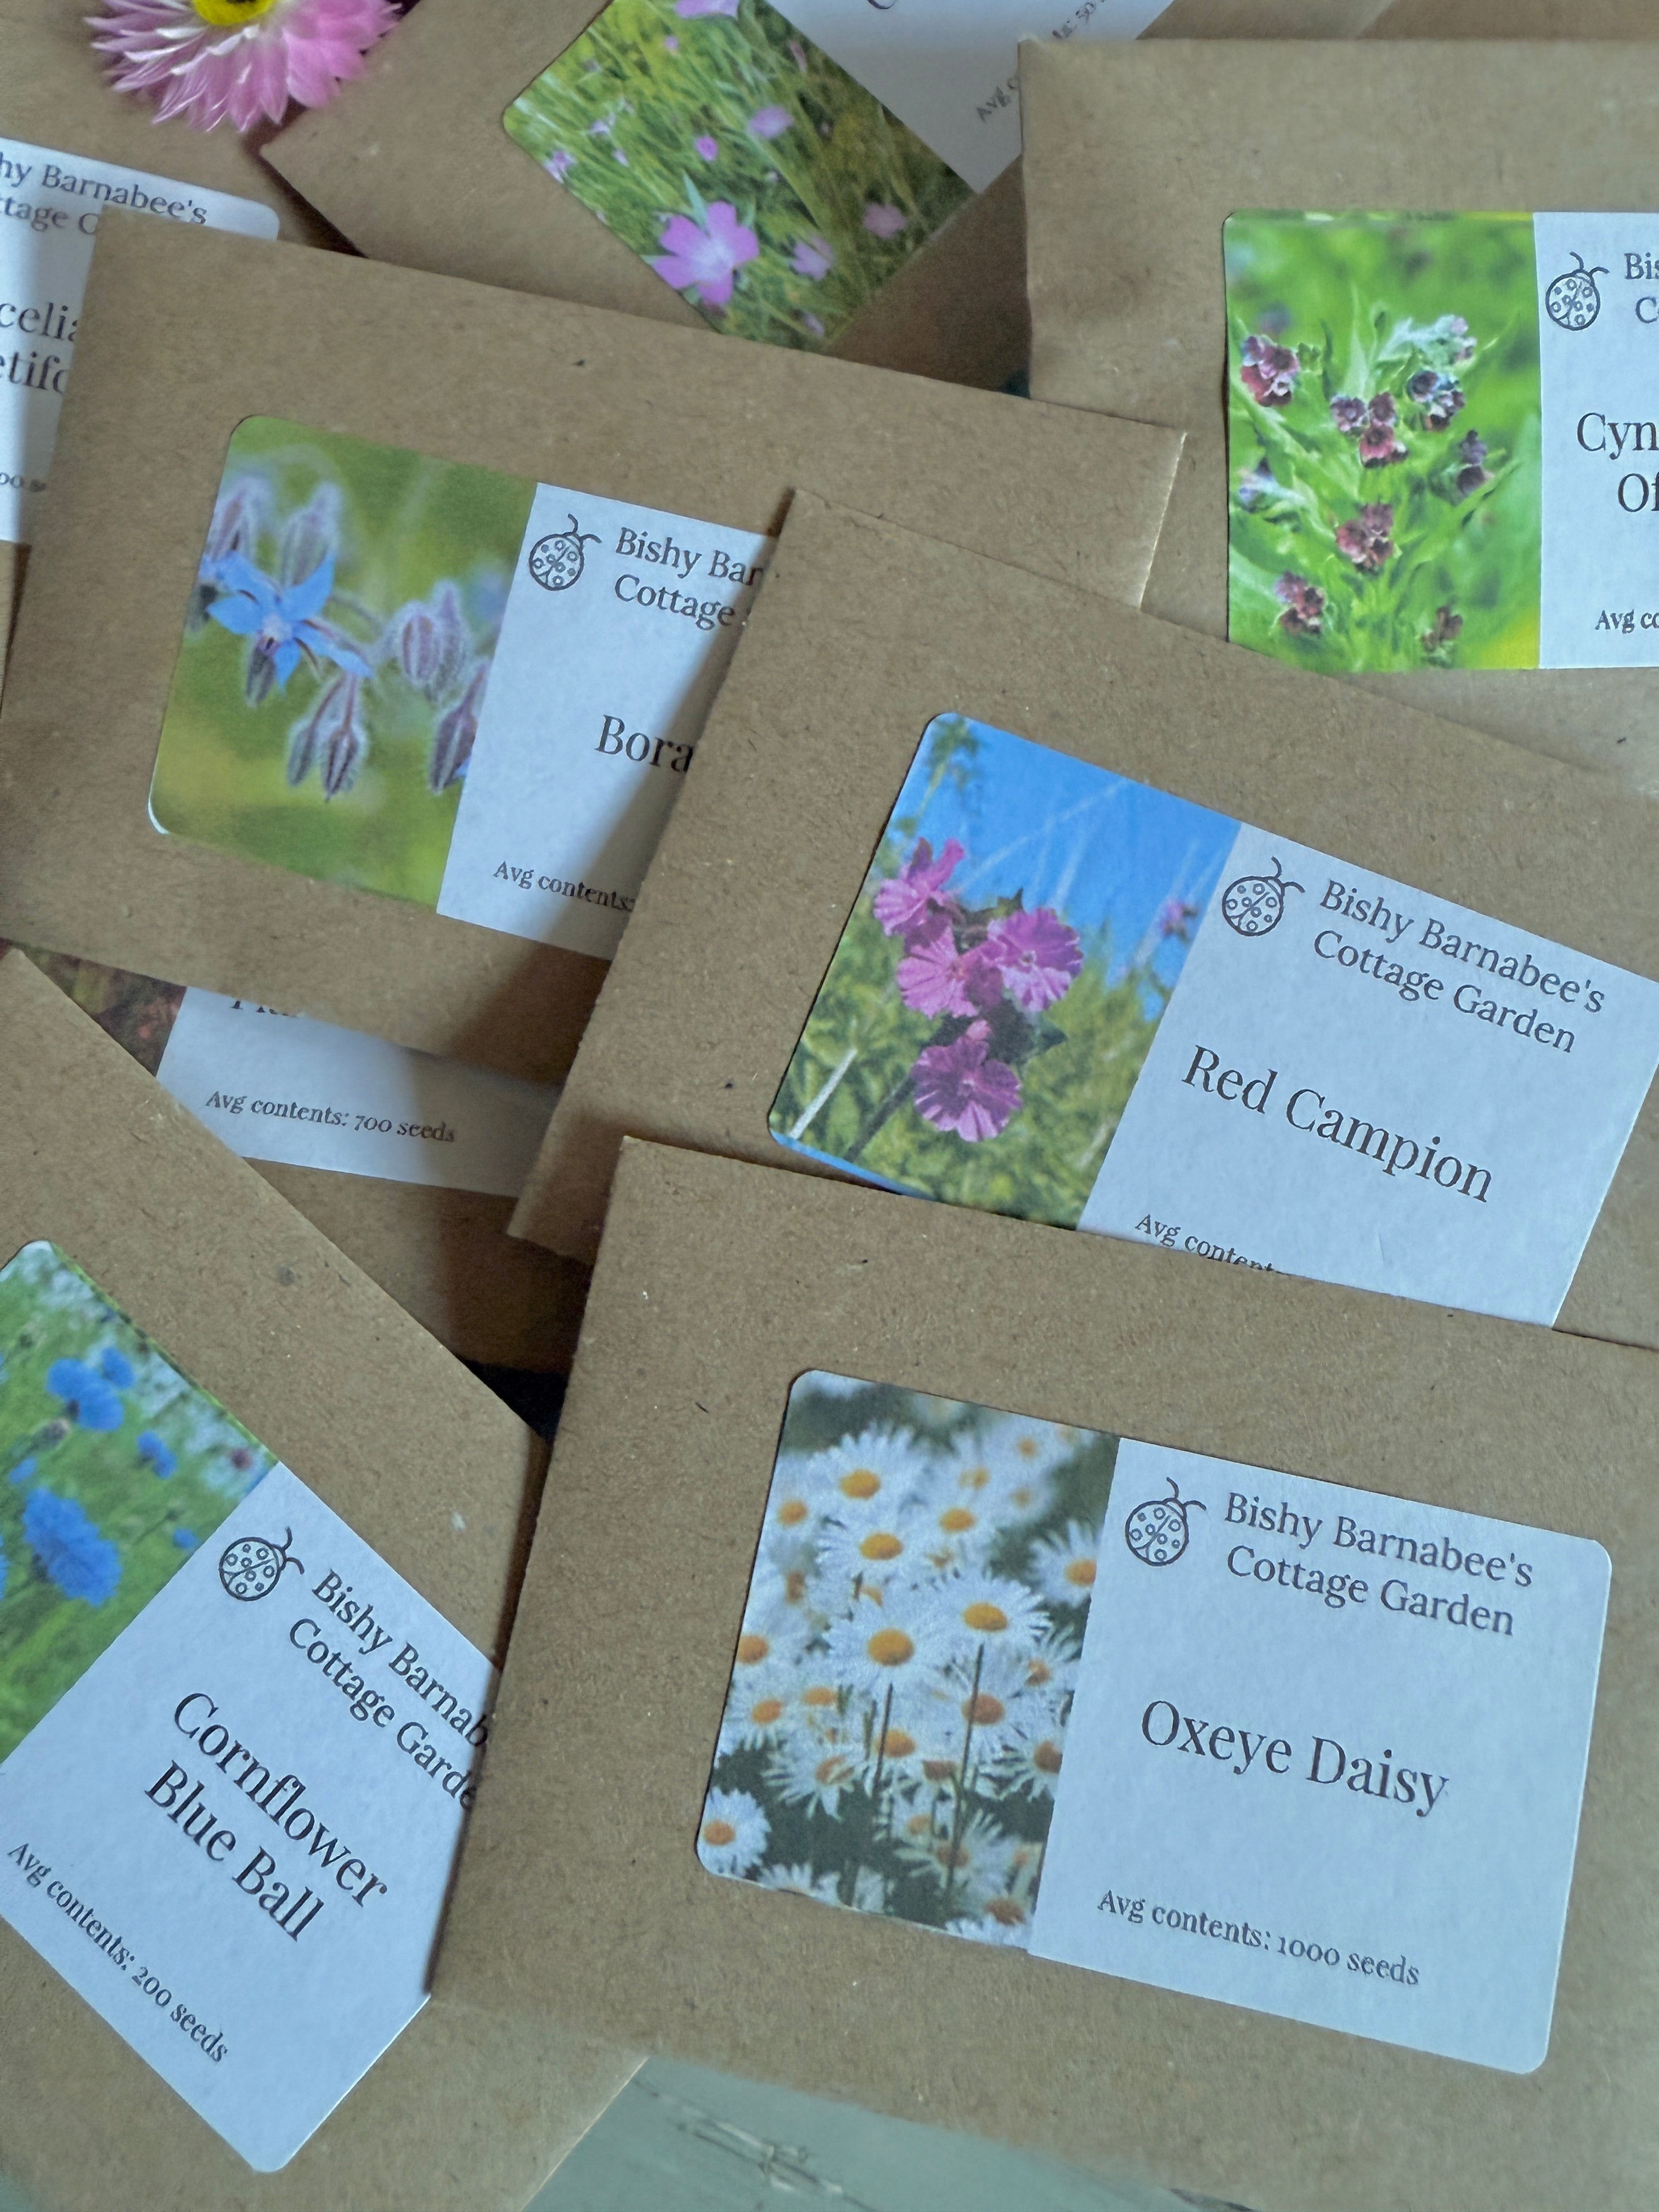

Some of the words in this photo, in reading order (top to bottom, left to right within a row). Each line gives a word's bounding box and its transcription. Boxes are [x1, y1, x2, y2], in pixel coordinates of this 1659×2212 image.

[0, 196, 69, 232] tage
[42, 163, 207, 224] Barnabee's
[614, 574, 735, 630] Cottage
[616, 527, 702, 579] Bishy
[708, 549, 764, 585] Bar
[1594, 610, 1635, 634] Avg
[595, 714, 694, 772] Bora
[493, 861, 534, 889] Avg
[1314, 930, 1444, 1001] Cottage
[1453, 984, 1575, 1053] Garden
[1319, 879, 1414, 944] Bishy
[1419, 918, 1605, 1013] Barnabee's
[205, 1091, 247, 1114] Avg
[250, 1099, 351, 1126] contents:
[354, 1114, 392, 1132] 700
[397, 1121, 454, 1143] seeds
[1181, 1045, 1278, 1114] Red
[1286, 1088, 1492, 1203] Campion
[1135, 1214, 1181, 1246] Avg
[1224, 1492, 1323, 1549] Bishy
[1333, 1516, 1533, 1587] Barnabee's
[1227, 1545, 1369, 1609] Cottage
[1380, 1579, 1513, 1636] Garden
[290, 1618, 396, 1728] Cottage
[312, 1569, 393, 1655] Bishy
[388, 1642, 488, 1746] Barnab
[173, 1692, 388, 1908] Cornflower
[1142, 1700, 1292, 1775] Oxeye
[1306, 1736, 1449, 1818] Daisy
[144, 1760, 236, 1862] Blue
[232, 1845, 324, 1943] Ball
[7, 1843, 52, 1888] Avg
[47, 1880, 135, 1971] contents:
[131, 1966, 172, 2008] 200
[170, 2003, 228, 2063] seeds
[1098, 1889, 1146, 1923] Avg
[1152, 1905, 1271, 1951] contents:
[1278, 1936, 1340, 1966] 1000
[1346, 1955, 1420, 1985] seeds
